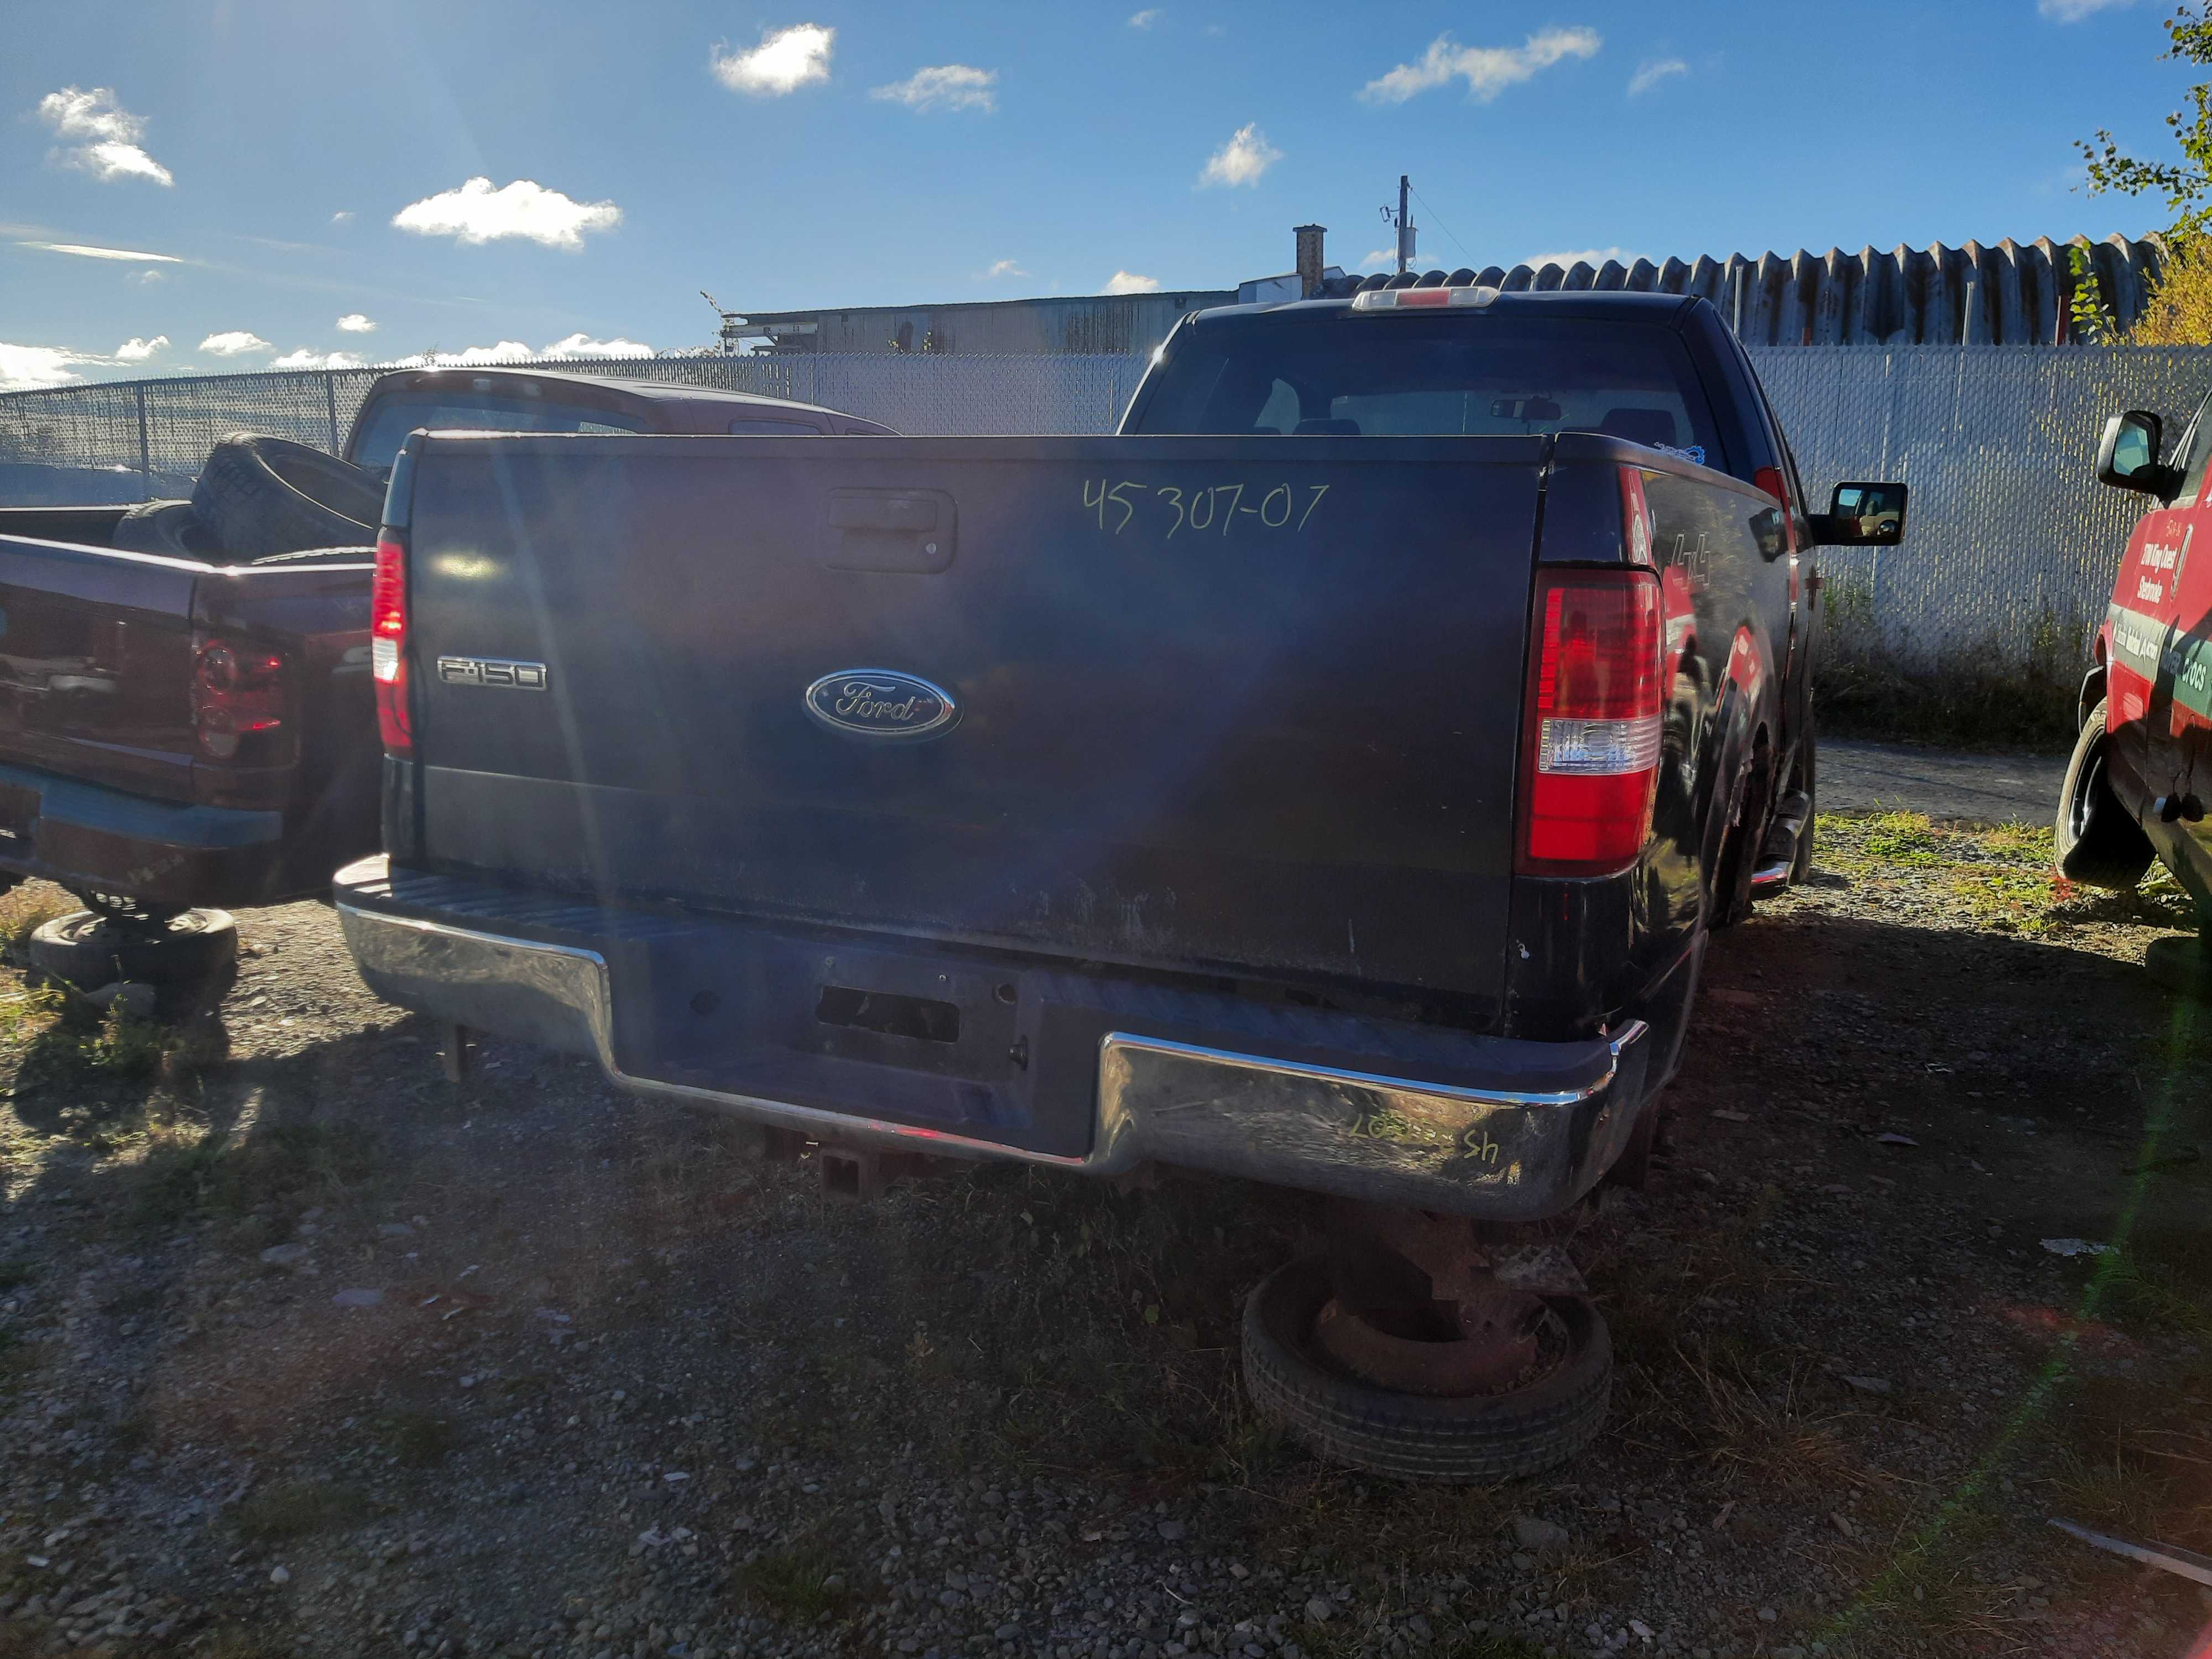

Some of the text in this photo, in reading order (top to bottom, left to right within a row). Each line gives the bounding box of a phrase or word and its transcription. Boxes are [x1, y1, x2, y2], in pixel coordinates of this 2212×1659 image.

[1084, 479, 1329, 539] 45 307-07
[836, 682, 916, 721] Ford
